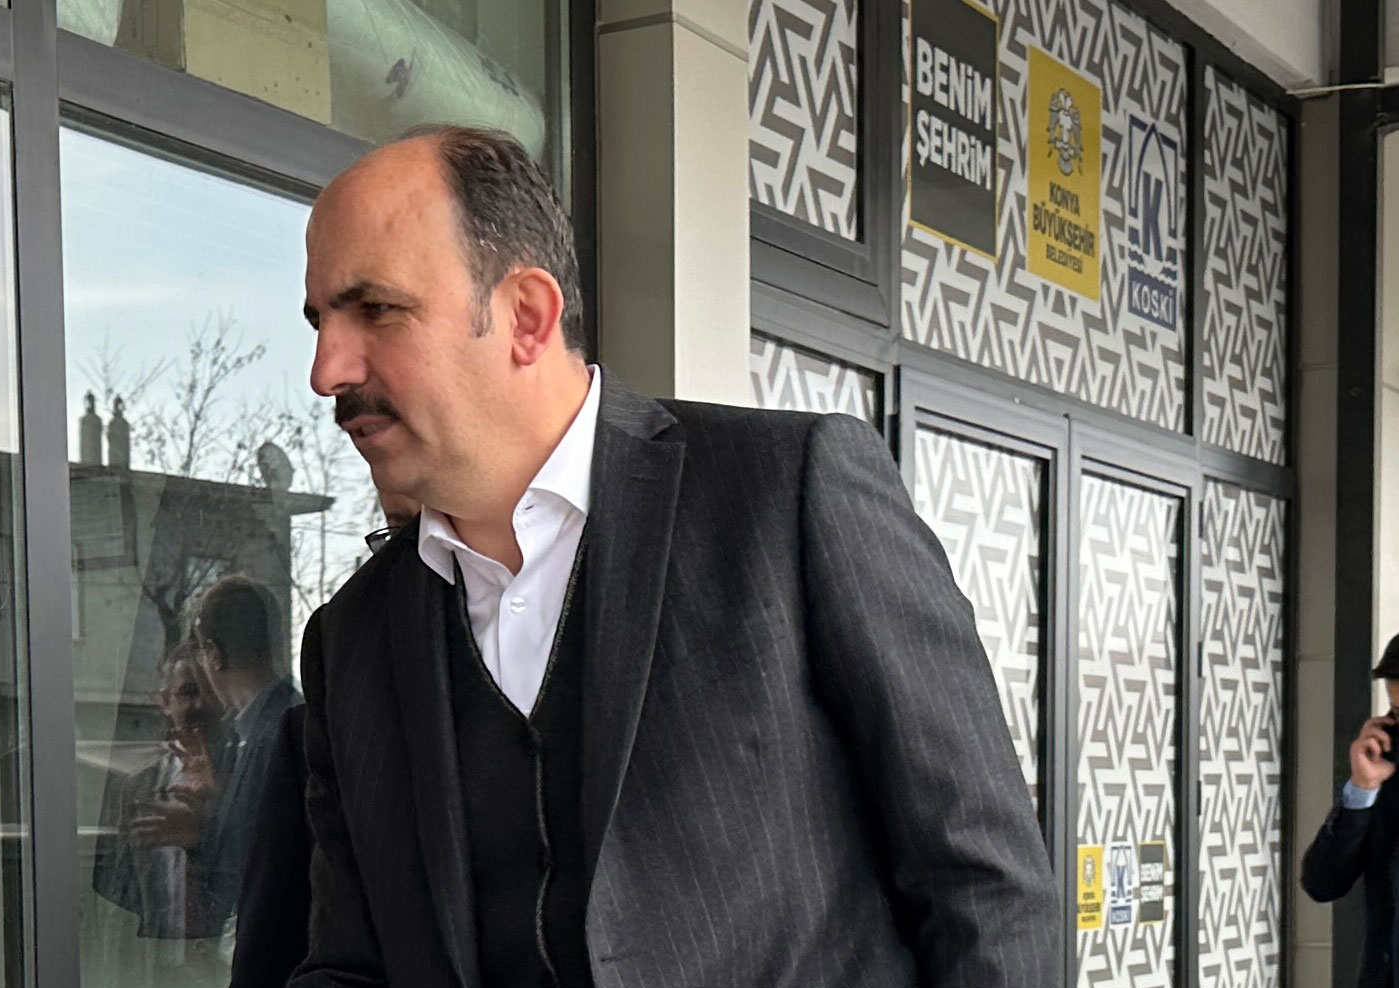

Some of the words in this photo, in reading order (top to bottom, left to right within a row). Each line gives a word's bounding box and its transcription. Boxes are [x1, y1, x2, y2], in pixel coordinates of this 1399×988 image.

[916, 36, 992, 131] BENİM
[916, 109, 992, 191] ŞEHRİM
[1049, 181, 1080, 217] KONYA
[1033, 201, 1095, 258] BÜYÜKŞEHİR
[1131, 281, 1174, 325] KOSKİ
